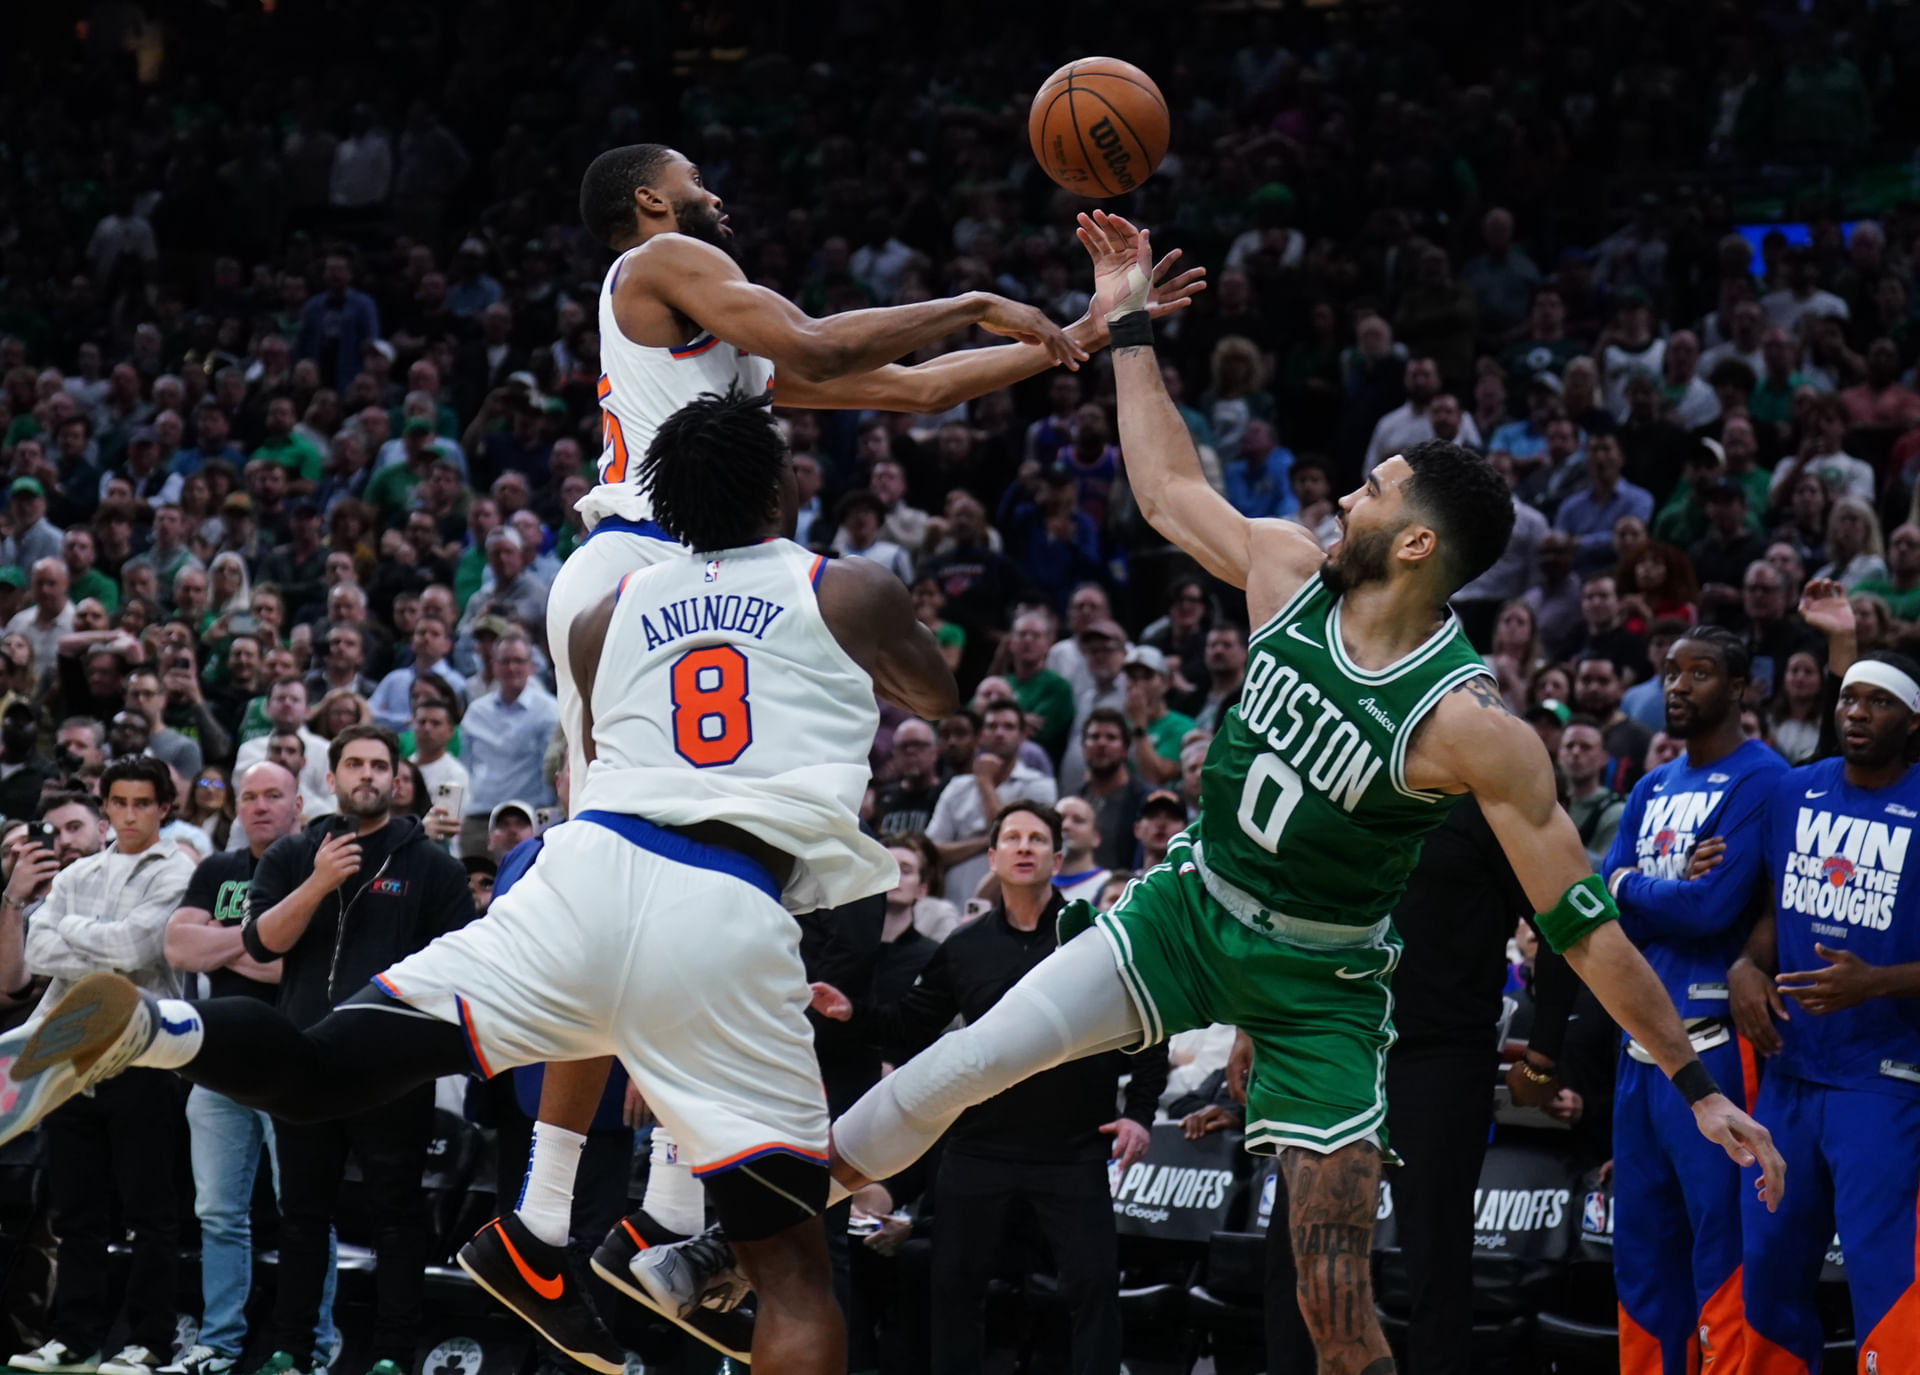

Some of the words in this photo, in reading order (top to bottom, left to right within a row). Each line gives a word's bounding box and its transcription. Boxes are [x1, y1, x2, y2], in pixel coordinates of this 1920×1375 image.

[1090, 115, 1136, 190] Wilson
[641, 594, 784, 651] ANUNOBY
[670, 643, 753, 768] 8
[1239, 650, 1383, 812] BOSTON
[1357, 696, 1396, 735] Amica
[1236, 751, 1304, 854] 0
[1638, 790, 1725, 837] WIN
[1795, 806, 1912, 873] WIN
[1785, 851, 1824, 880] FOR
[1853, 864, 1901, 895] THE
[1567, 882, 1606, 919] 0
[1781, 872, 1896, 932] BOROUGHS
[1118, 1162, 1234, 1210] PLAYOFFS
[1473, 1188, 1570, 1232] LAYOFFS
[1125, 1203, 1170, 1223] Google
